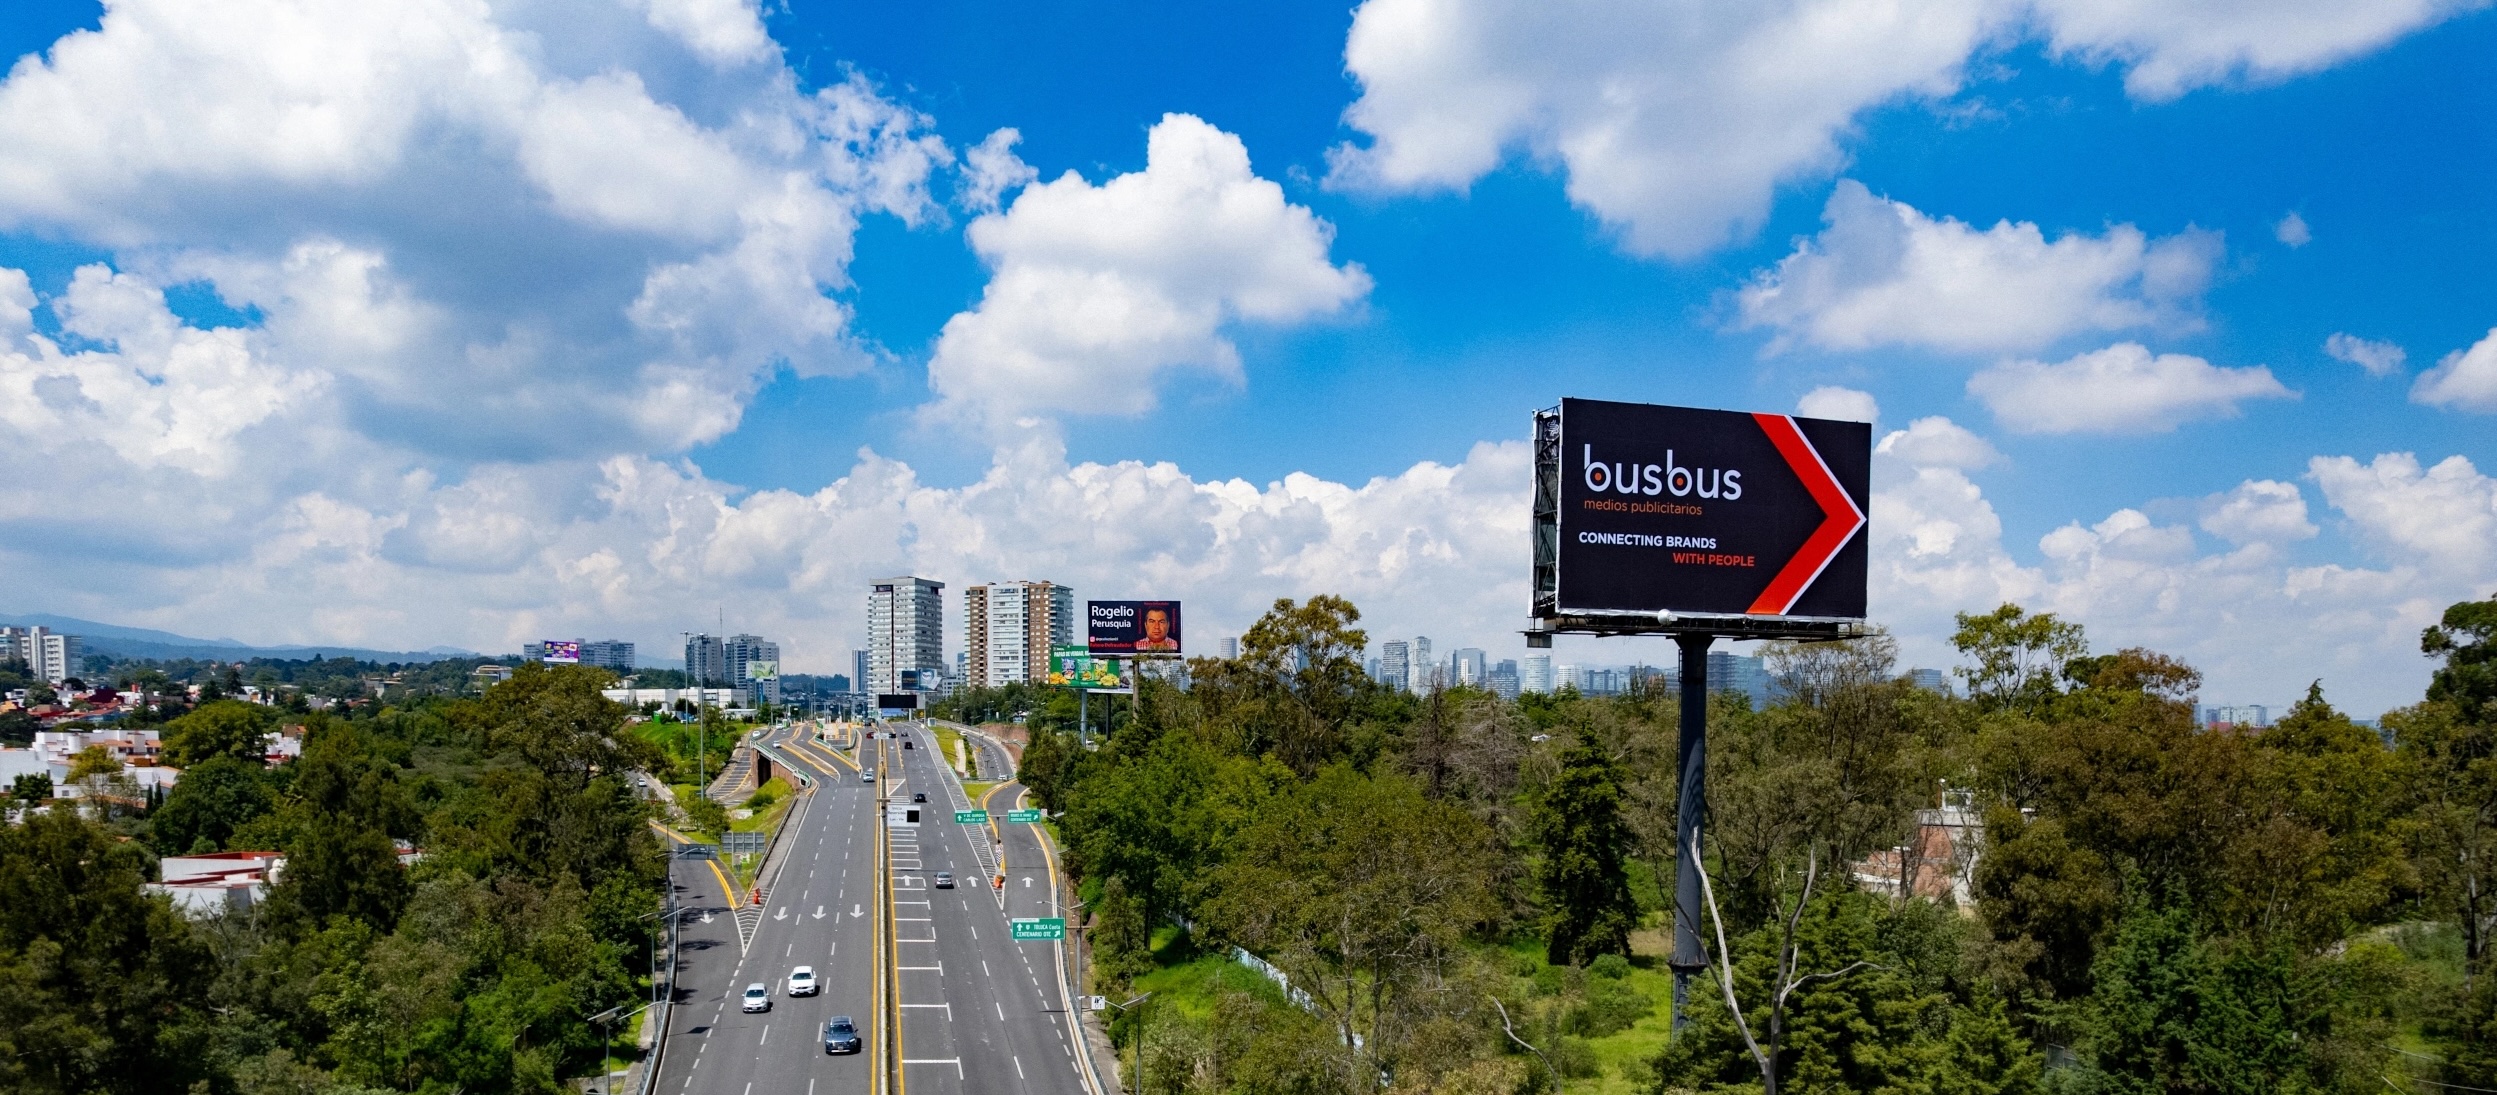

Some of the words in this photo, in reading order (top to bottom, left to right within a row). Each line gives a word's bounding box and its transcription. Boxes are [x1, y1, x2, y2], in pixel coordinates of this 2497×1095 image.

[1584, 443, 1742, 500] busbus
[1584, 499, 1628, 512] medios
[1631, 501, 1702, 516] publicitarios
[1578, 531, 1663, 547] CONNECTING
[1666, 535, 1717, 550] BRANDS
[1673, 552, 1706, 566] WITH
[1709, 554, 1755, 567] PEOPLE
[1091, 605, 1134, 619] Rogelio
